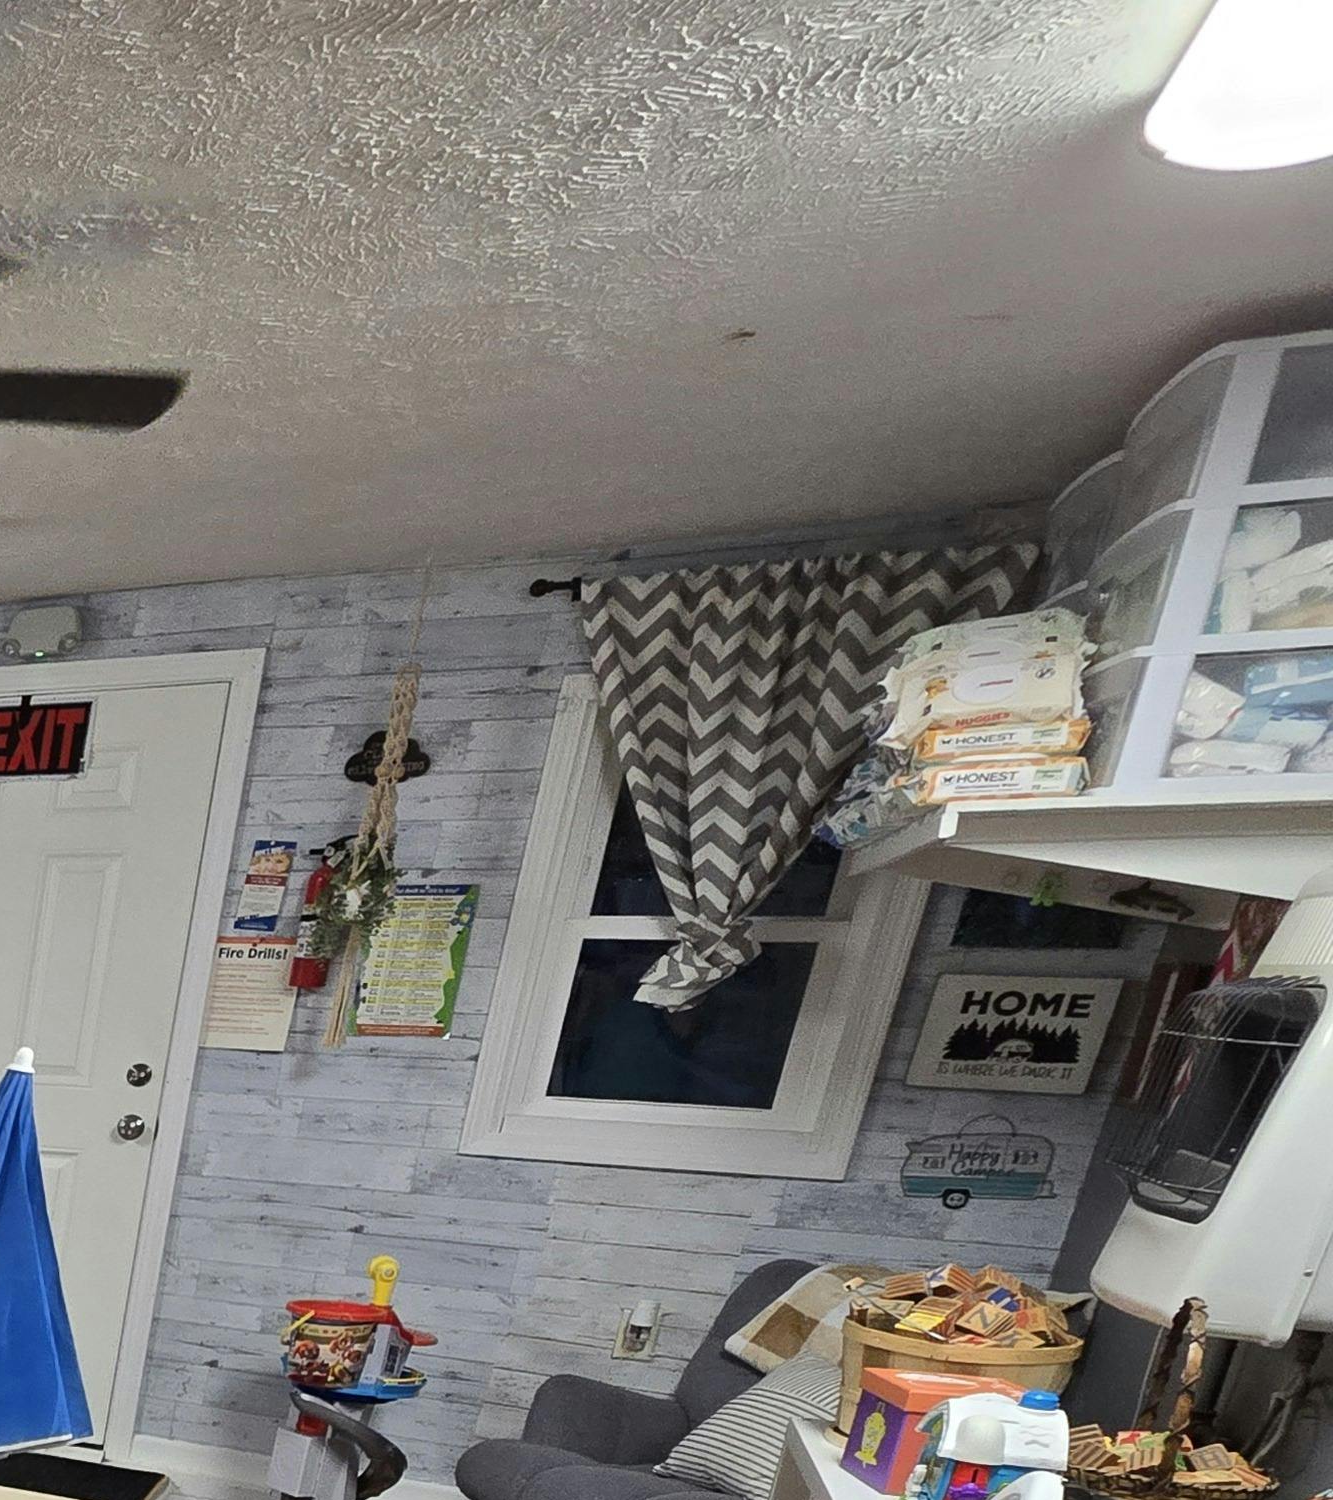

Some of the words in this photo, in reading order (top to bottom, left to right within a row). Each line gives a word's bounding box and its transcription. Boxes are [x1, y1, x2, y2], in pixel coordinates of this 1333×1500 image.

[955, 732, 1017, 745] HONEST
[956, 771, 1021, 783] HONEST
[218, 947, 245, 960] Fire
[248, 947, 288, 961] Drills!
[960, 990, 1096, 1018] HOME
[936, 1061, 949, 1074] IS
[954, 1063, 994, 1076] WHERE
[998, 1064, 1018, 1076] WE
[1022, 1067, 1056, 1079] PARK
[1059, 1068, 1075, 1080] IT
[948, 1143, 1001, 1168] Happy
[951, 1162, 1015, 1180] Camper
